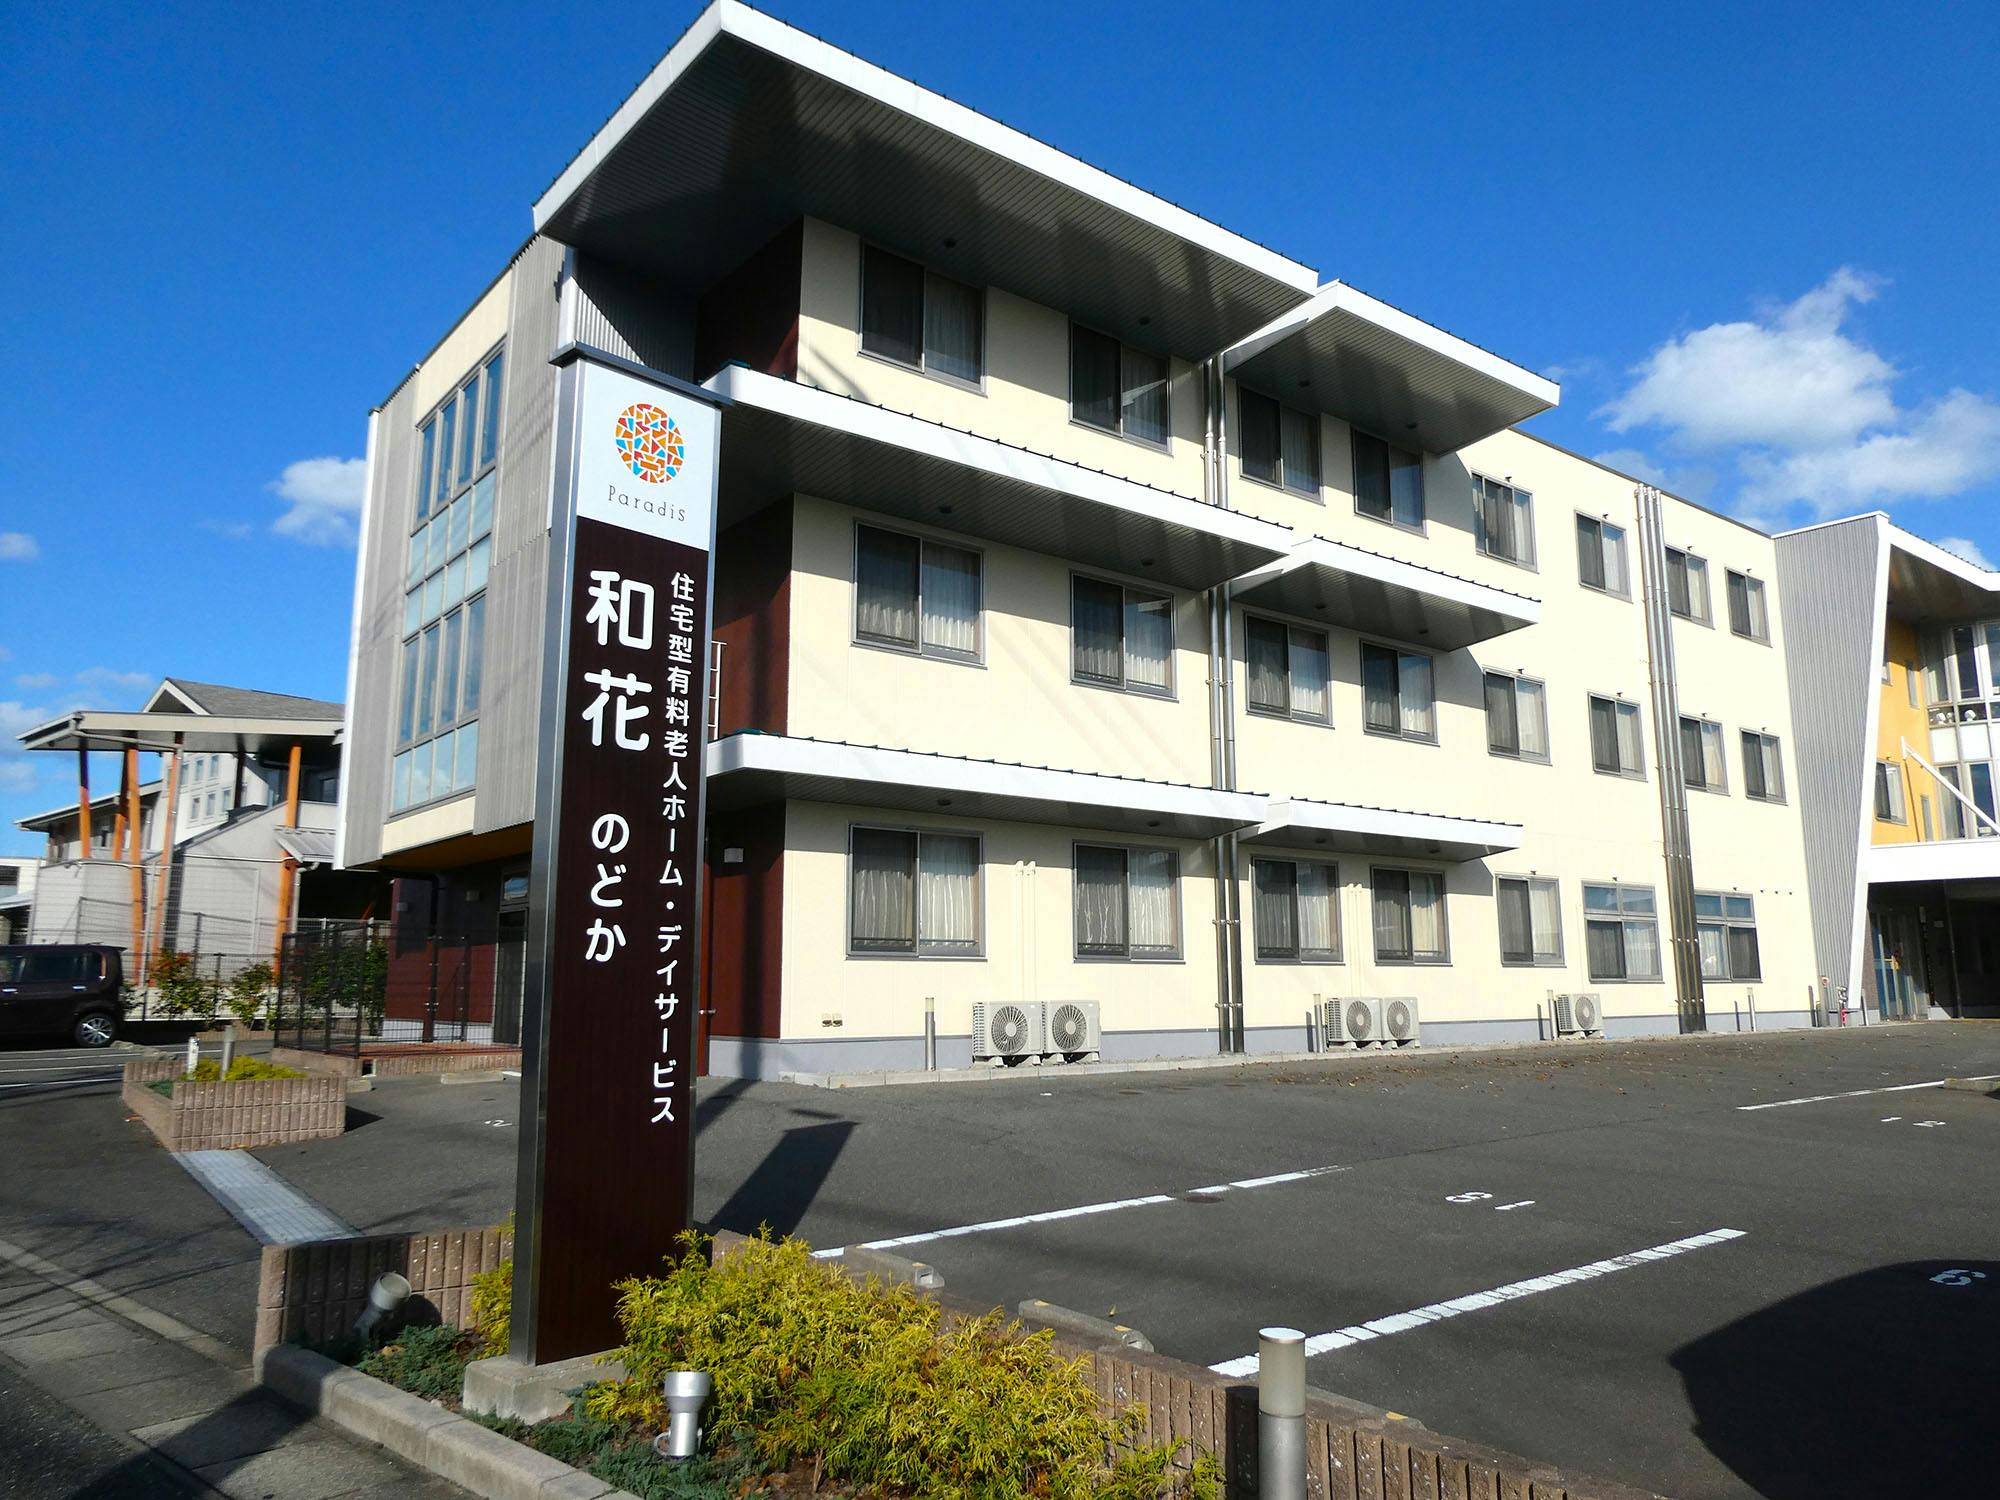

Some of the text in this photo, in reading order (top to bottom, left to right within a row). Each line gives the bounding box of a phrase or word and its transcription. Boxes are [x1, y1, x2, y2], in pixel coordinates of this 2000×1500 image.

[608, 484, 686, 522] Paradis
[581, 570, 655, 962] 和花 のどか
[650, 571, 695, 1123] 住宅型有料老人ホーム・デイサービス
